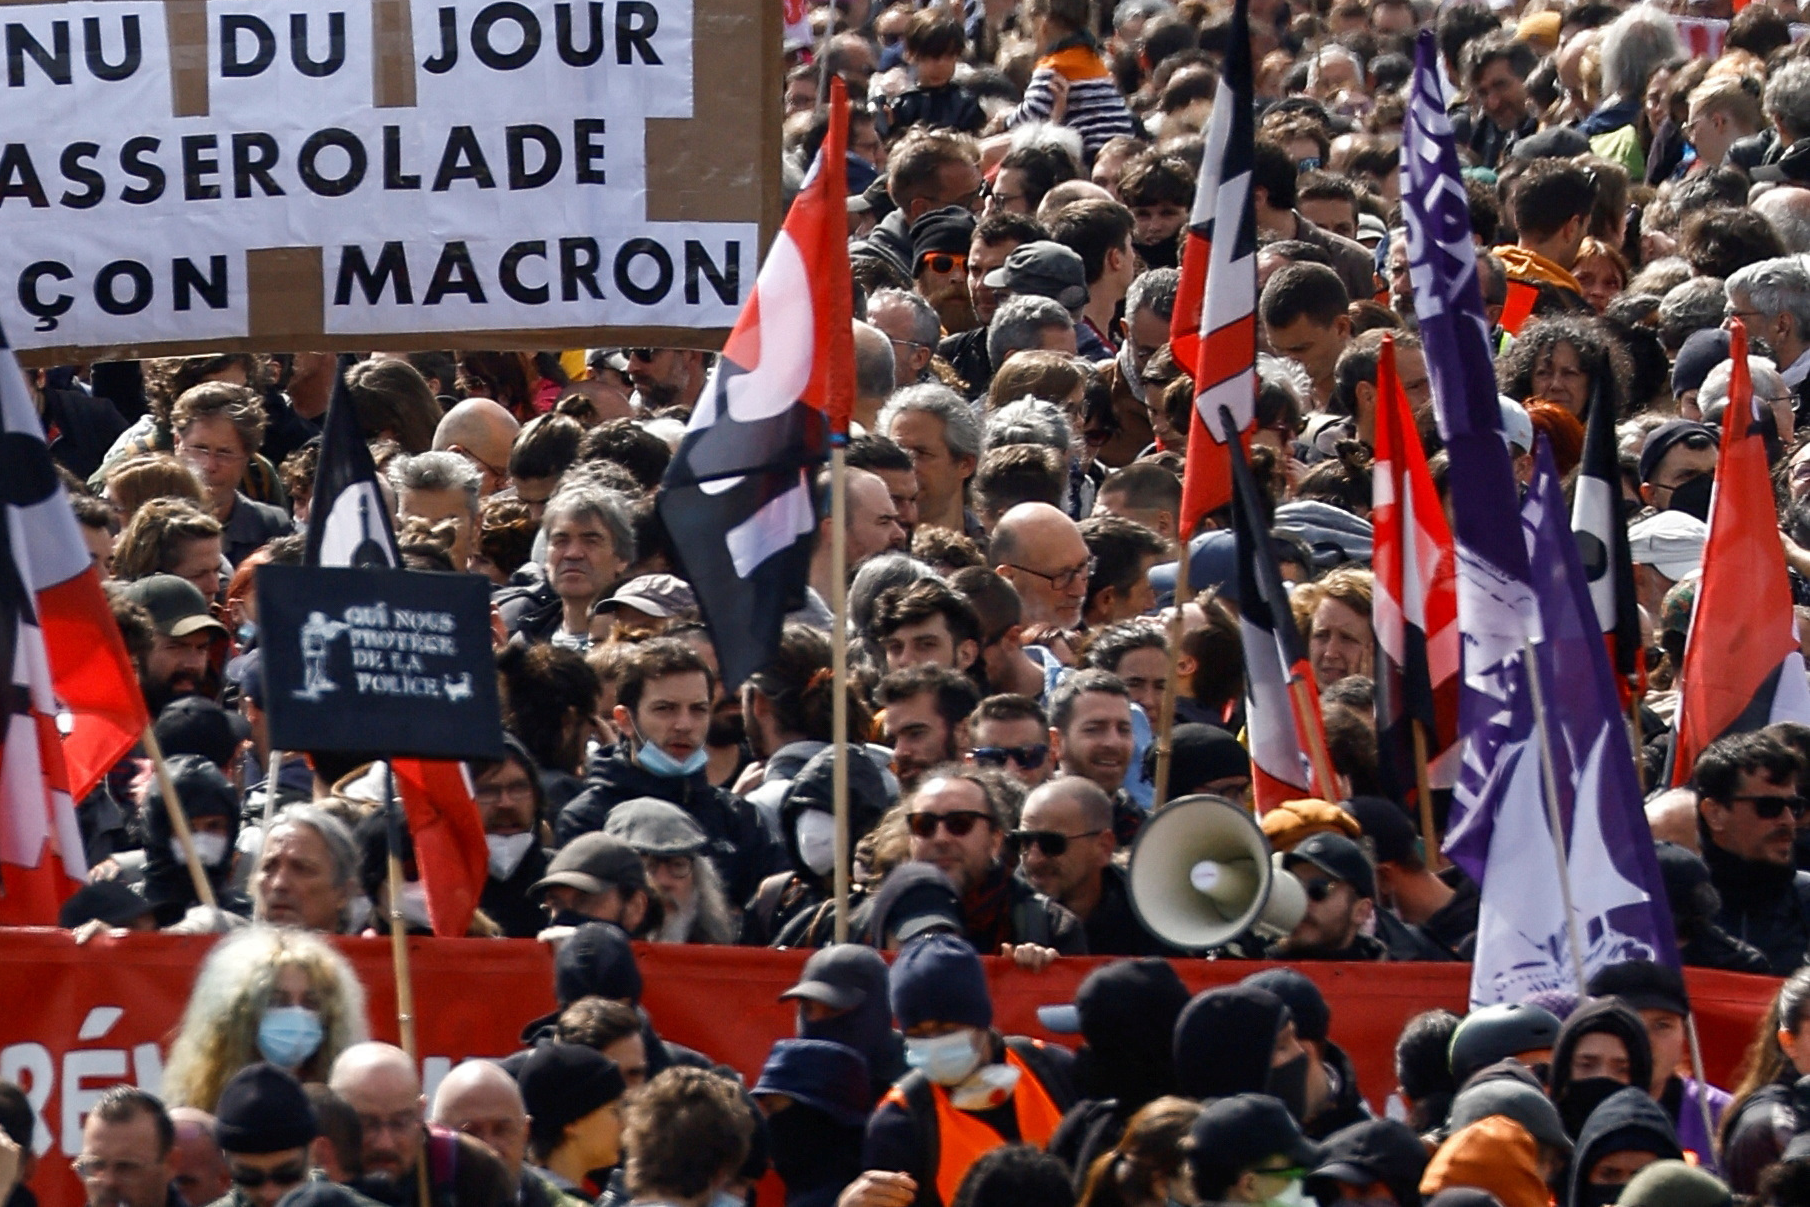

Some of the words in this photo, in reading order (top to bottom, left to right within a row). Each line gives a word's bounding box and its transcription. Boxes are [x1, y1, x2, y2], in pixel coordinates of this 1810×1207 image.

[220, 11, 347, 79] DU
[421, 0, 664, 76] JOUR
[333, 237, 742, 307] MACRON
[393, 609, 456, 632] NOUS
